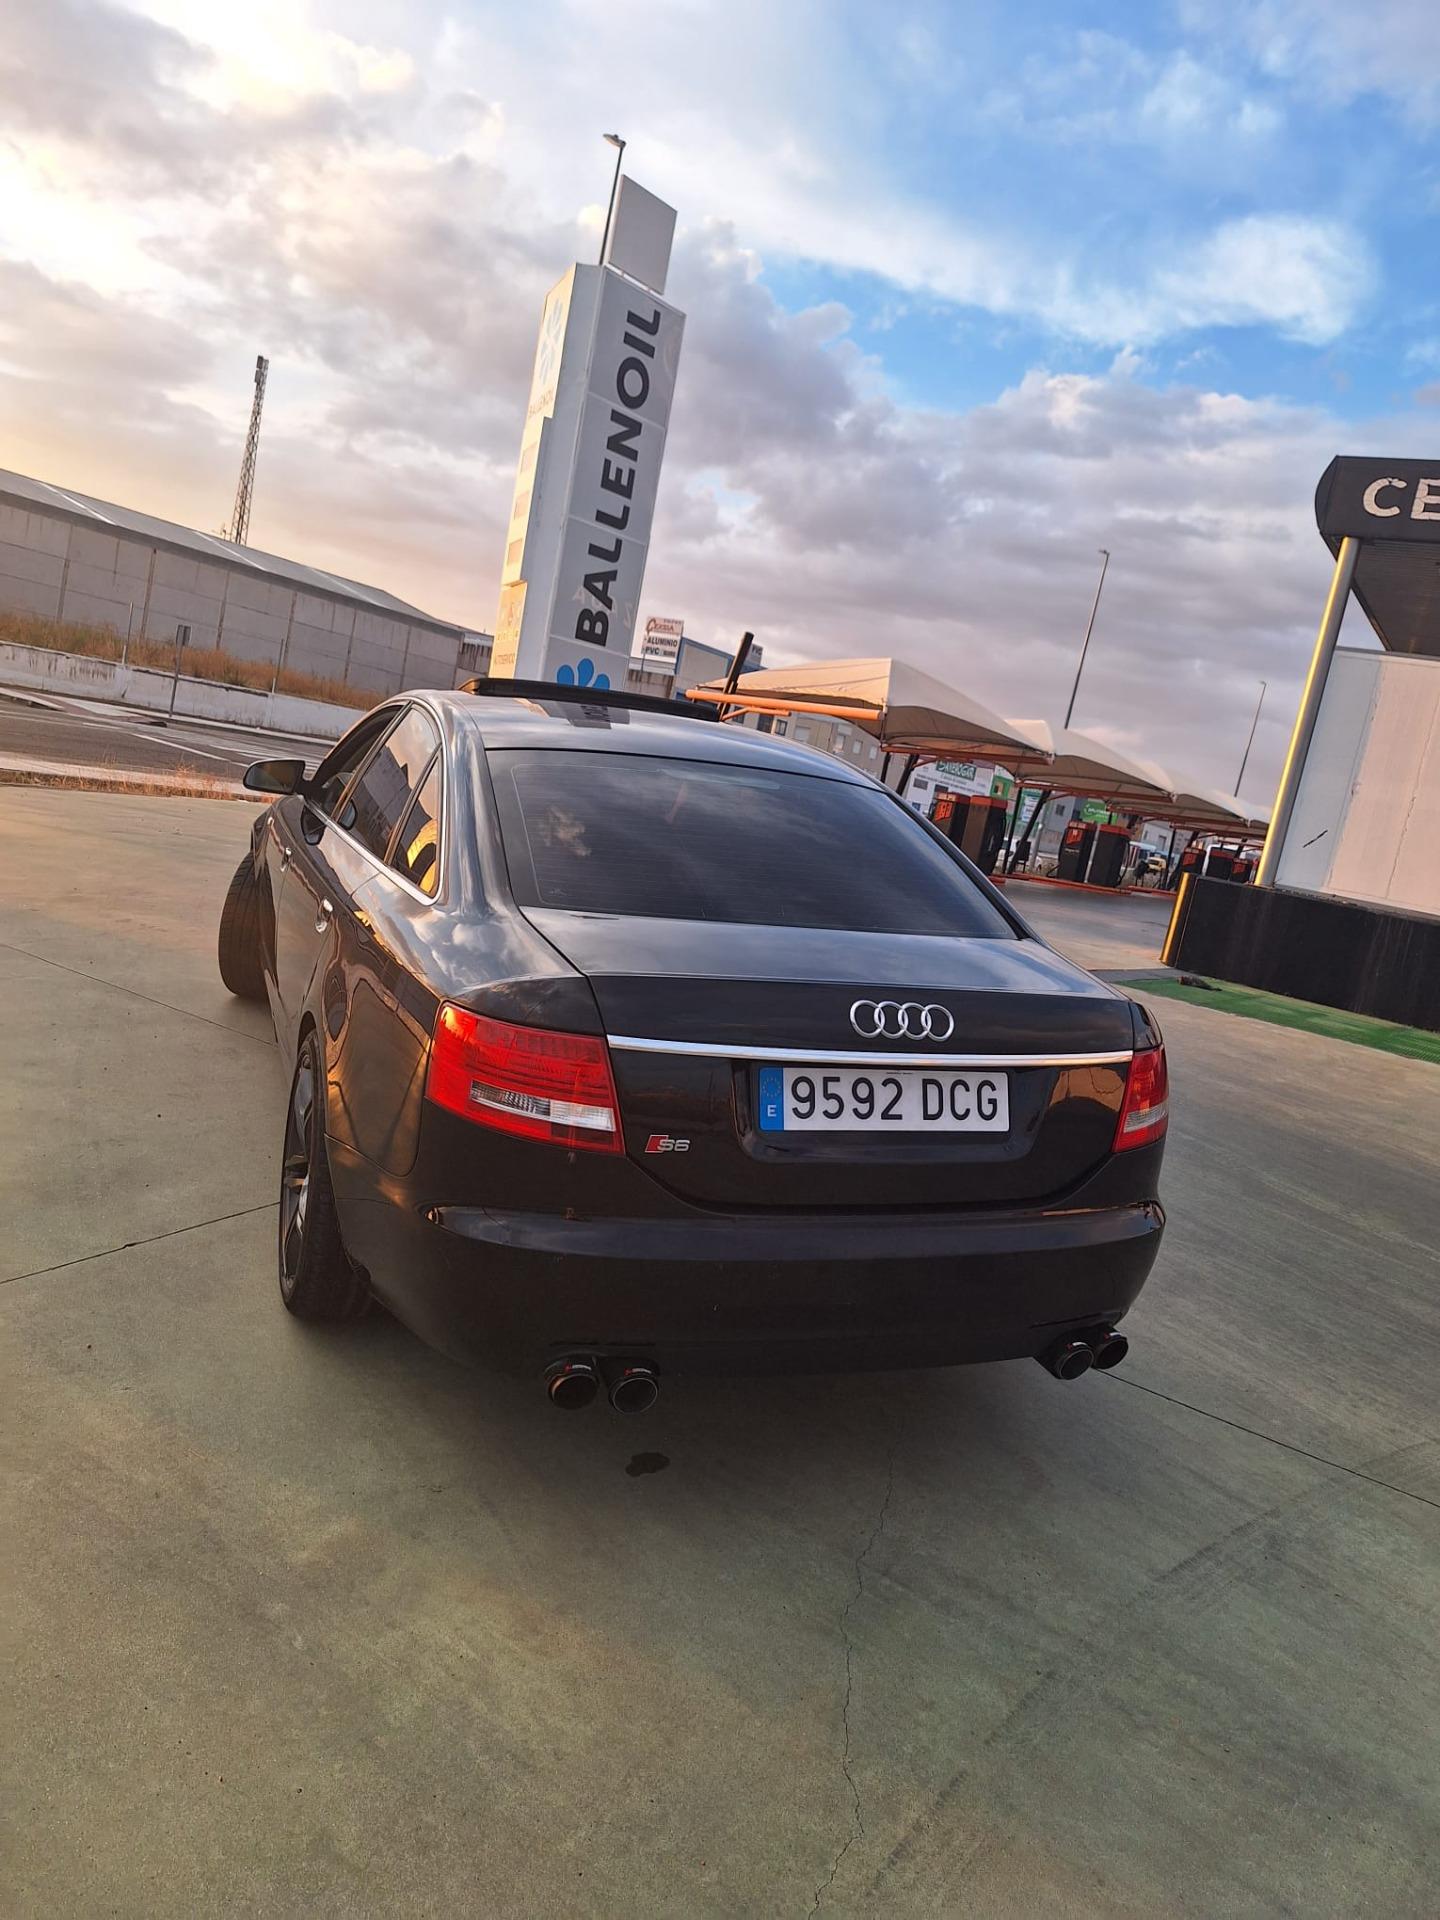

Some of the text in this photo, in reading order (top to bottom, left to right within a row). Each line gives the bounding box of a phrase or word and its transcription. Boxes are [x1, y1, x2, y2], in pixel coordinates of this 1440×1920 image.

[575, 308, 661, 647] BALLENOIL
[647, 636, 678, 647] ALUMINIO
[645, 646, 660, 655] PVC
[791, 1075, 999, 1121] 9592 DCG
[767, 1104, 777, 1117] E
[655, 1138, 691, 1152] S6
